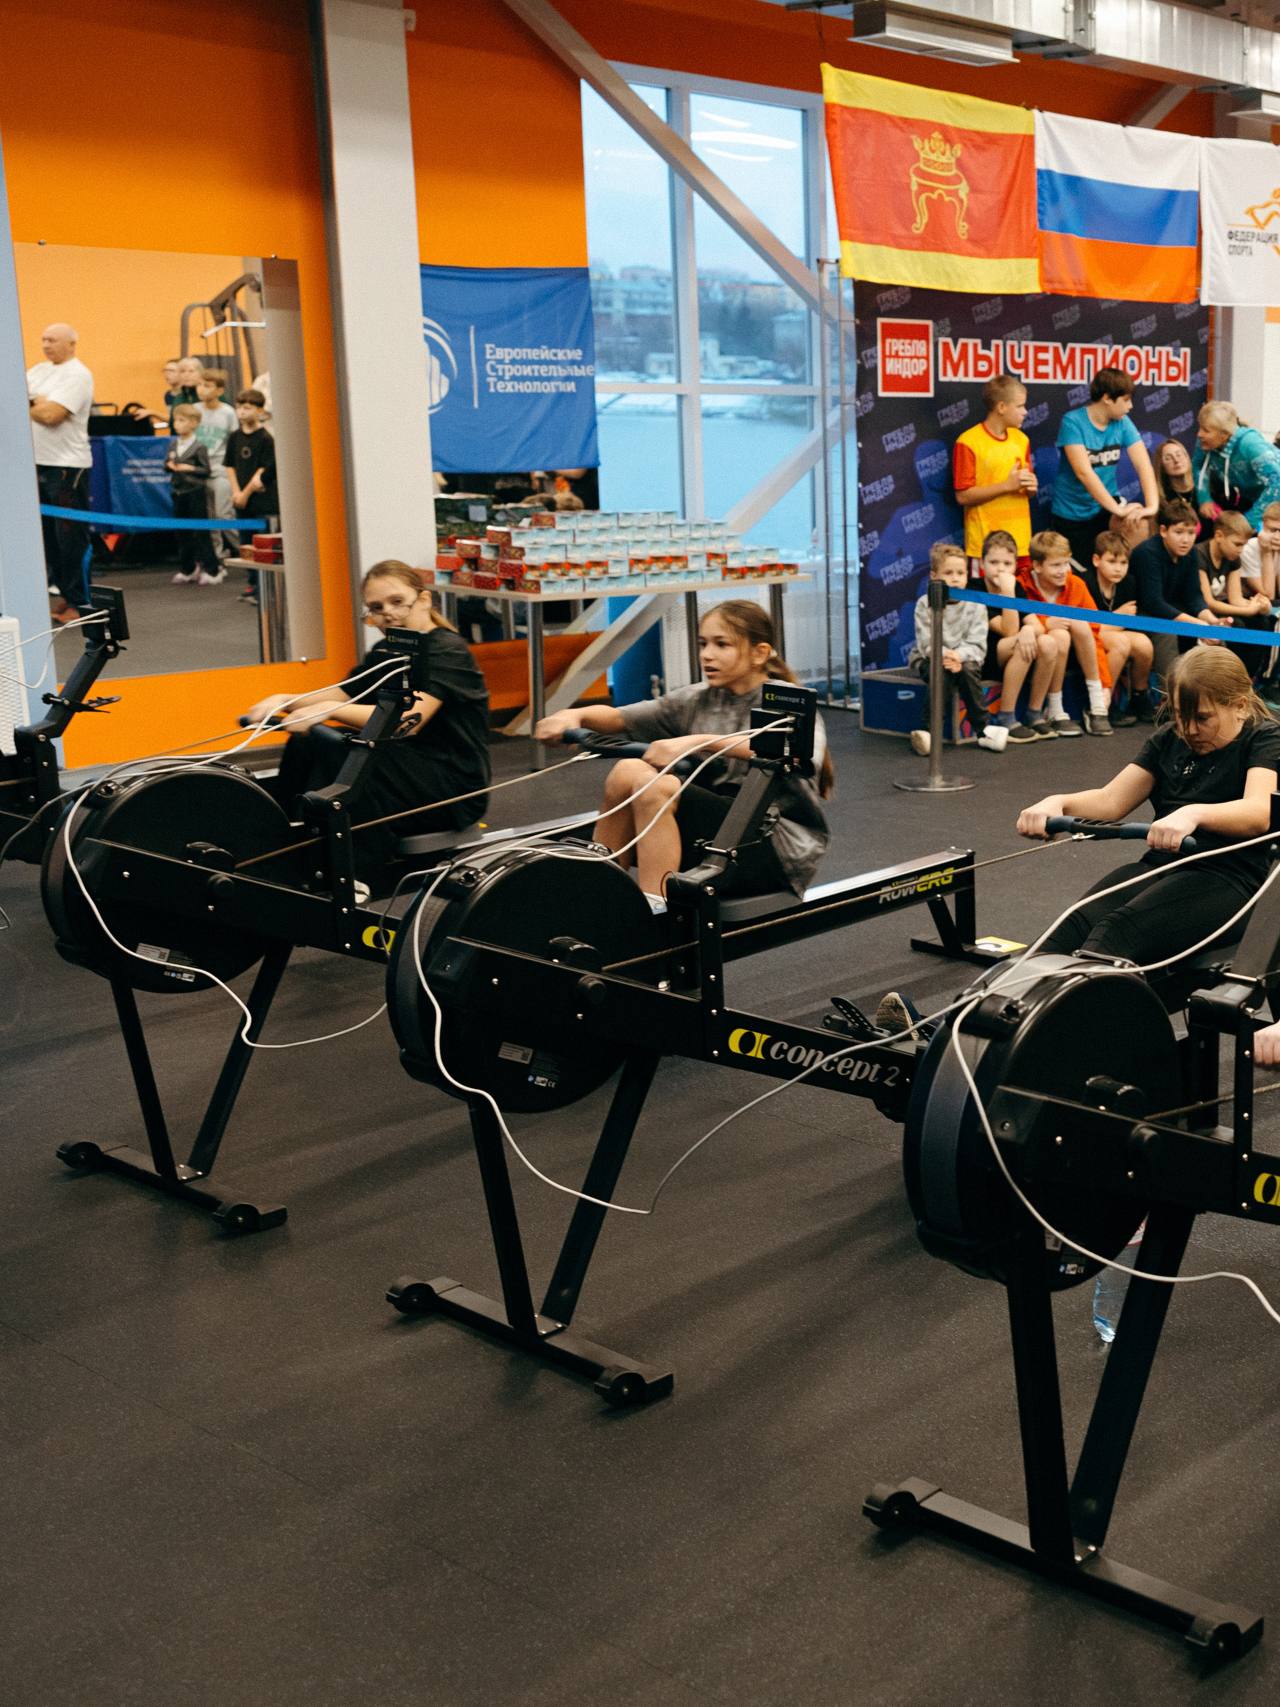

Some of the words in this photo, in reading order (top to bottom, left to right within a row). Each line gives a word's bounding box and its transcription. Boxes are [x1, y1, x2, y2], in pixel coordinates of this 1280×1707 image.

[1227, 230, 1279, 243] ФЕДЕРАЦИЯ
[1227, 244, 1253, 256] СПОРТА
[484, 344, 583, 363] Европейские
[885, 338, 928, 357] ГРЕБЛЯ
[485, 361, 594, 380] Строительные
[885, 358, 928, 379] ИНДОР
[938, 337, 1003, 382] МЫ
[1006, 340, 1191, 386] ЧЕМПИОНЫ
[486, 377, 577, 393] Технологии
[769, 1041, 882, 1083] concept
[882, 1065, 900, 1087] 2
